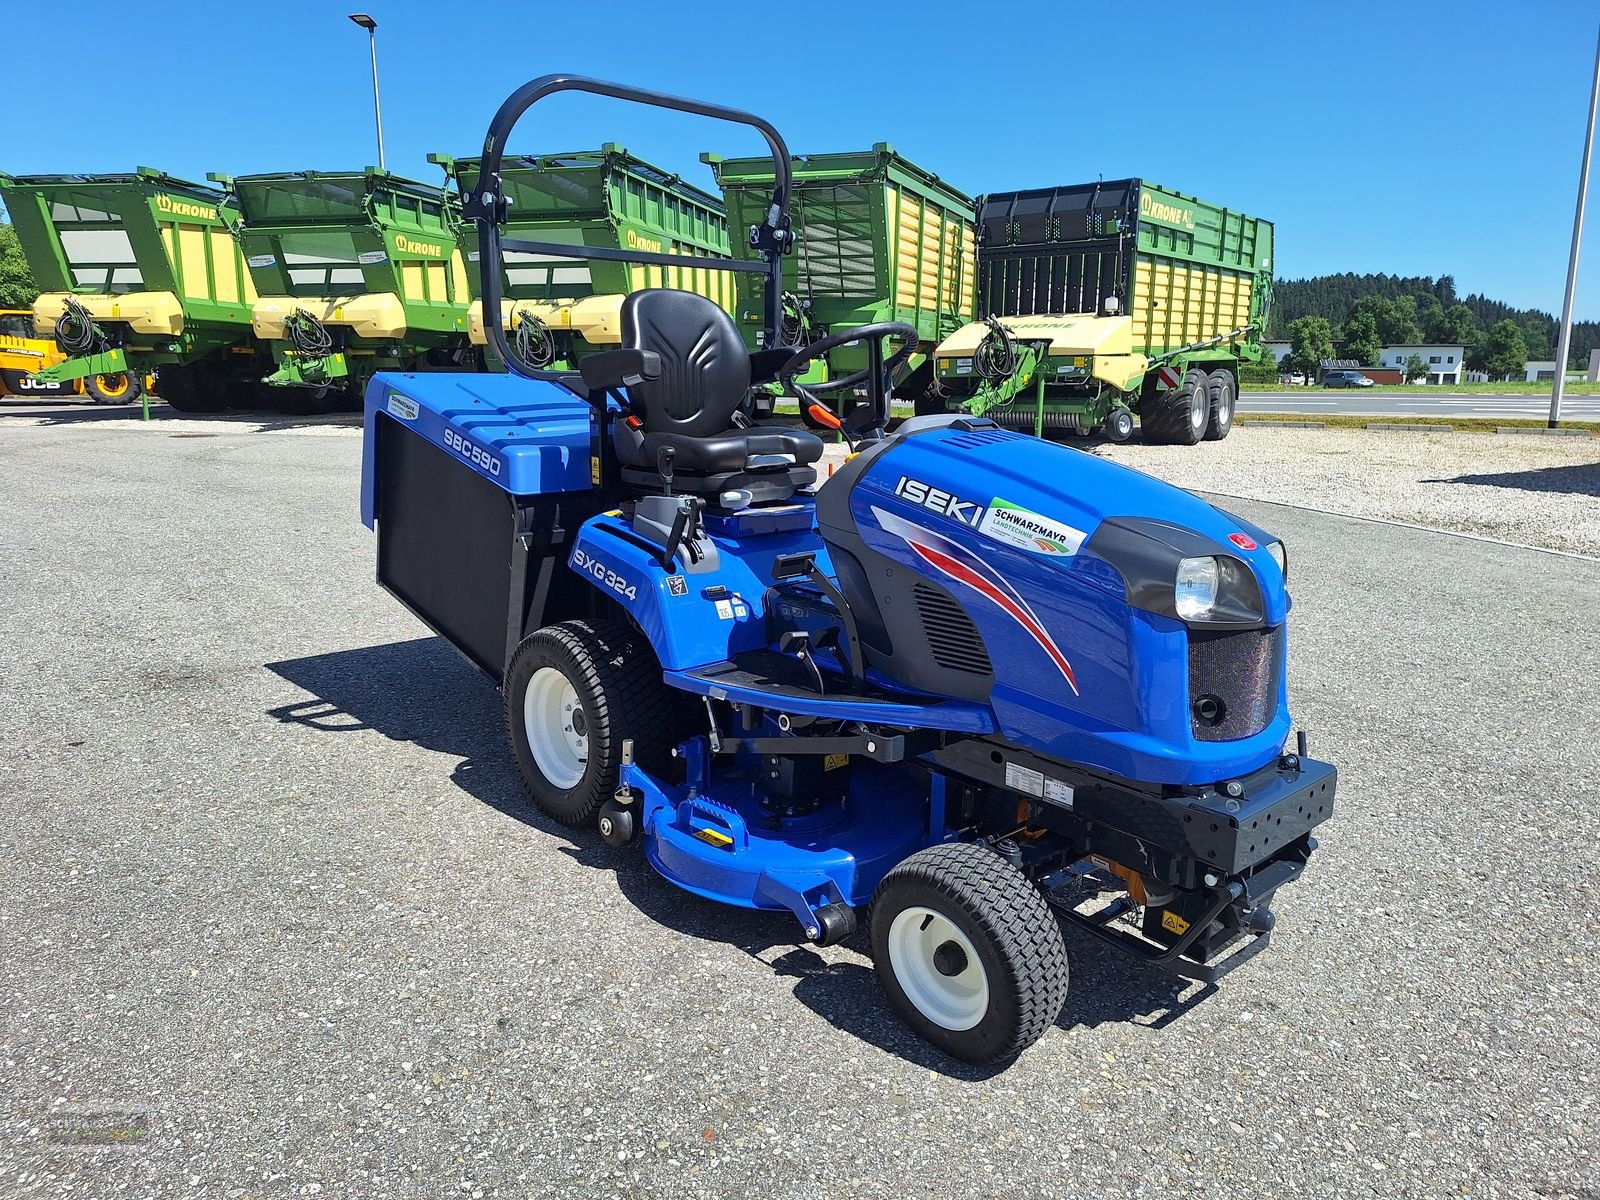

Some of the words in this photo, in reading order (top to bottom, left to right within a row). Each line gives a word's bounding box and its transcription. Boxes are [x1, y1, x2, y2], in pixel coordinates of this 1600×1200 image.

[172, 202, 216, 220] KRONE
[1151, 202, 1182, 224] KRONE
[407, 241, 441, 257] KRONE
[637, 236, 662, 253] KRONE
[20, 378, 61, 389] JCB
[443, 428, 501, 476] SBC590
[894, 475, 984, 527] ISEKI
[992, 518, 1034, 540] LANDTECHNIK
[994, 508, 1067, 544] SCHWARZMAYR
[574, 549, 637, 601] SXG324
